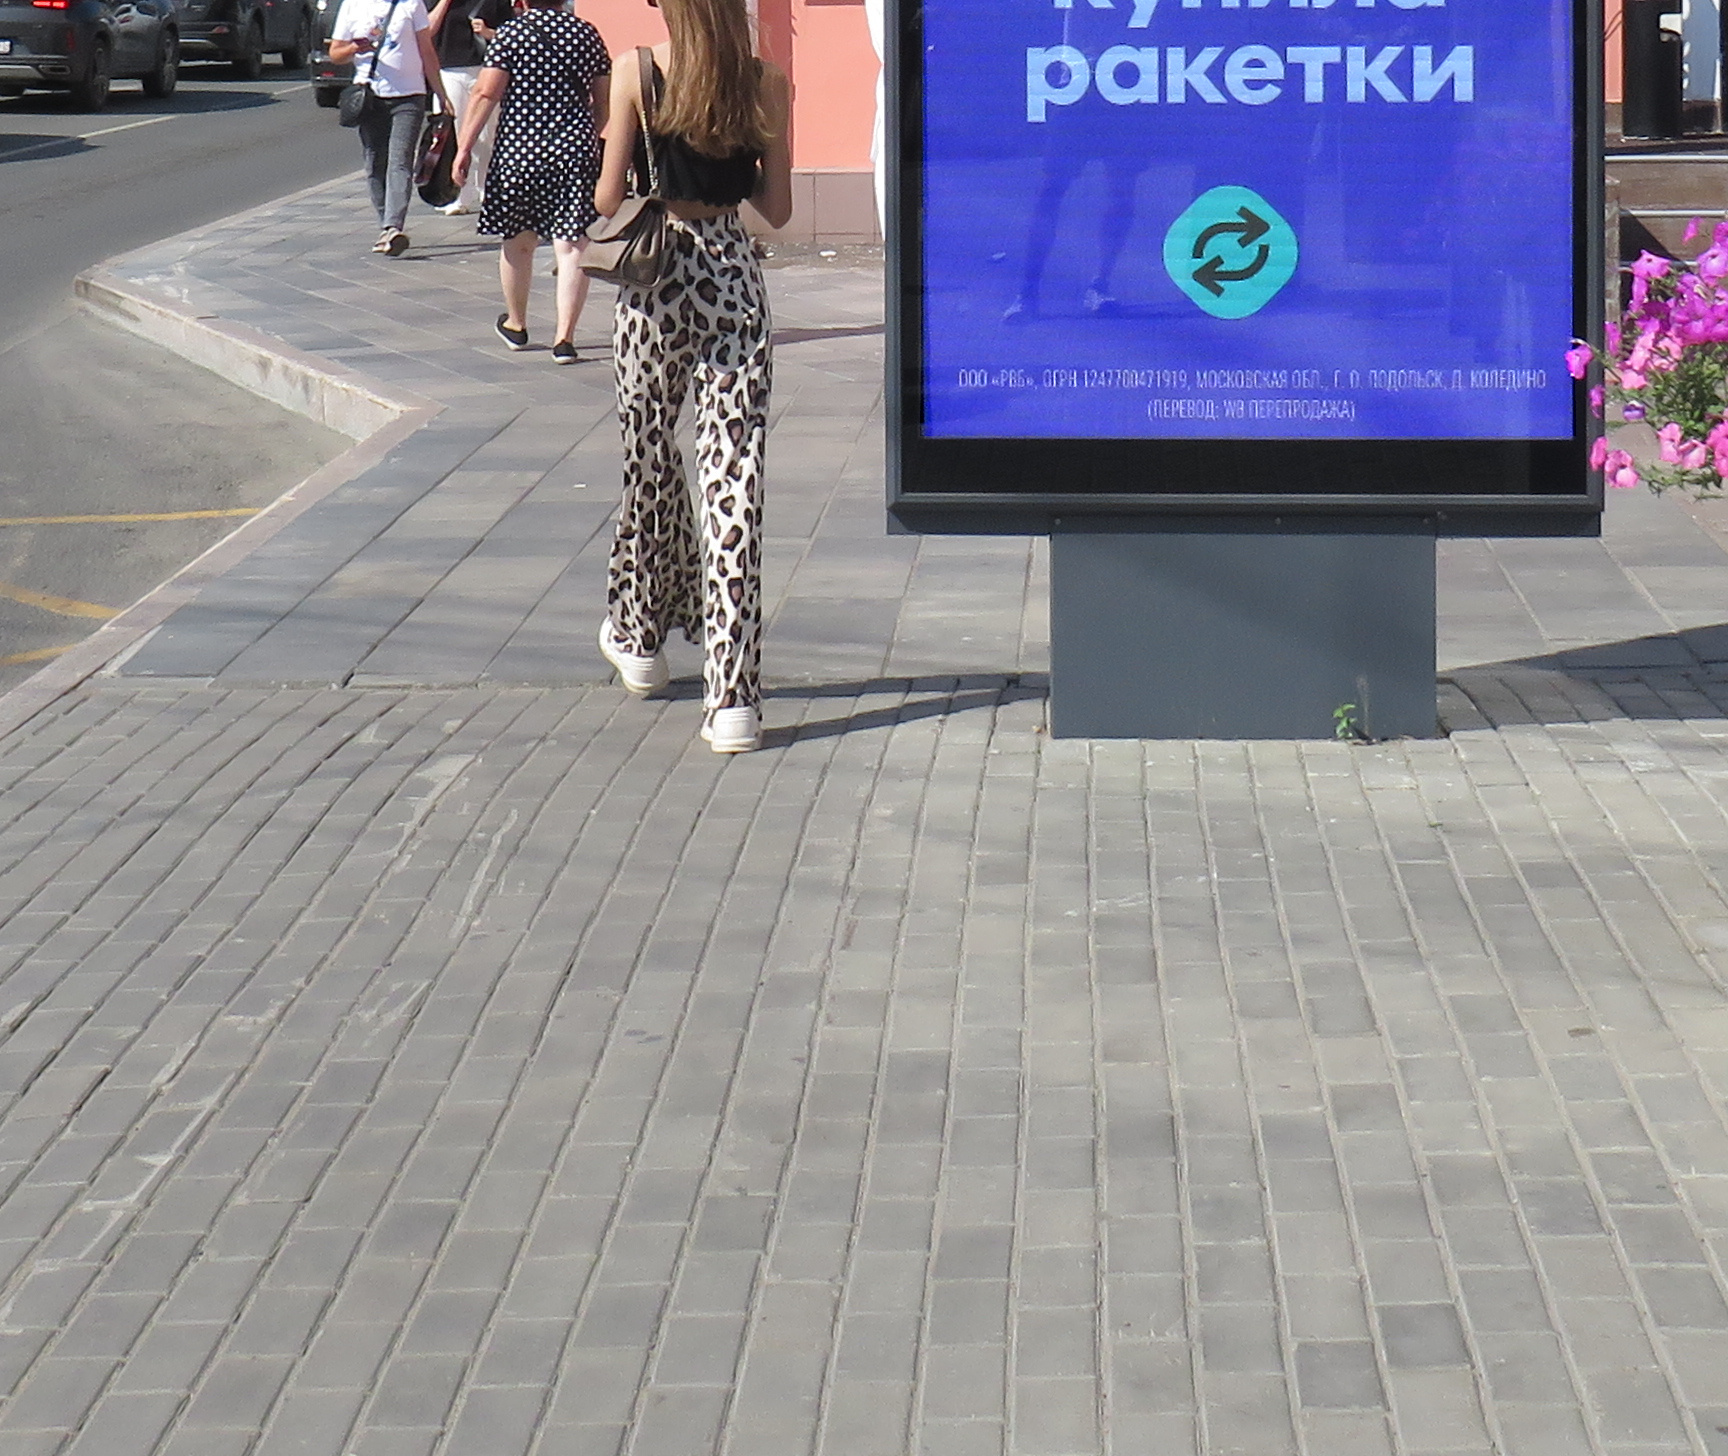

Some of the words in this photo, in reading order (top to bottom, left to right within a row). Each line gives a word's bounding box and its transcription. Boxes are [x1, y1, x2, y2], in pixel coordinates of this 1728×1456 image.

[1026, 43, 1473, 124] ракетки
[958, 368, 988, 388] ООО
[1042, 368, 1077, 388] ОГРН
[1196, 369, 1288, 389] МОСКОВСКАЯ
[1470, 369, 1547, 392] КОЛЕДИНО
[1146, 399, 1219, 422] (ПЕРЕВОД:
[1248, 399, 1356, 421] ПЕРЕПРОДАЖА)
